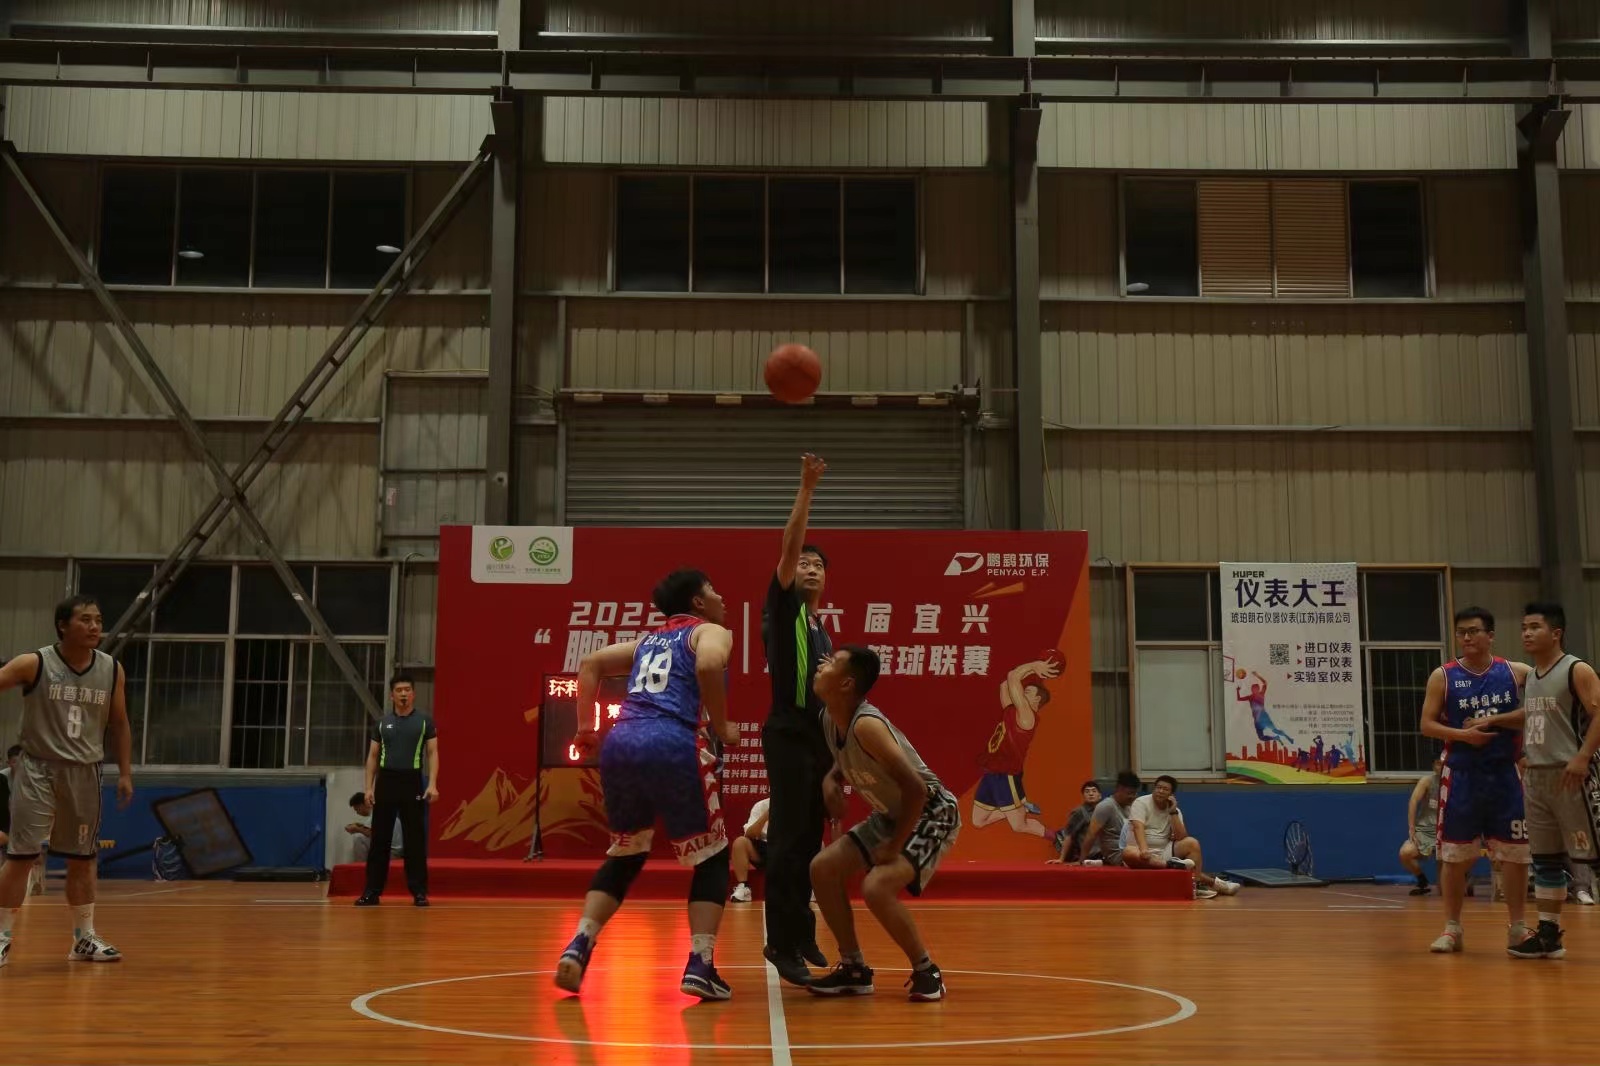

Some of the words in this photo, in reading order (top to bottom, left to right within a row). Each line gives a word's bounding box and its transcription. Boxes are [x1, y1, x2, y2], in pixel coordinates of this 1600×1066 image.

[987, 552, 1049, 567] 鹏鹞环保
[987, 568, 1026, 577] PENYAO
[1031, 568, 1049, 577] E.P.
[1232, 570, 1265, 578] HUPER
[1235, 578, 1346, 608] 仪表大王
[1305, 642, 1352, 654] 进口仪表
[1305, 656, 1352, 668] 国产仪表
[629, 648, 673, 694] 18
[1294, 671, 1353, 683] 实验室仪表
[67, 705, 82, 738] 8
[1525, 715, 1545, 745] 23
